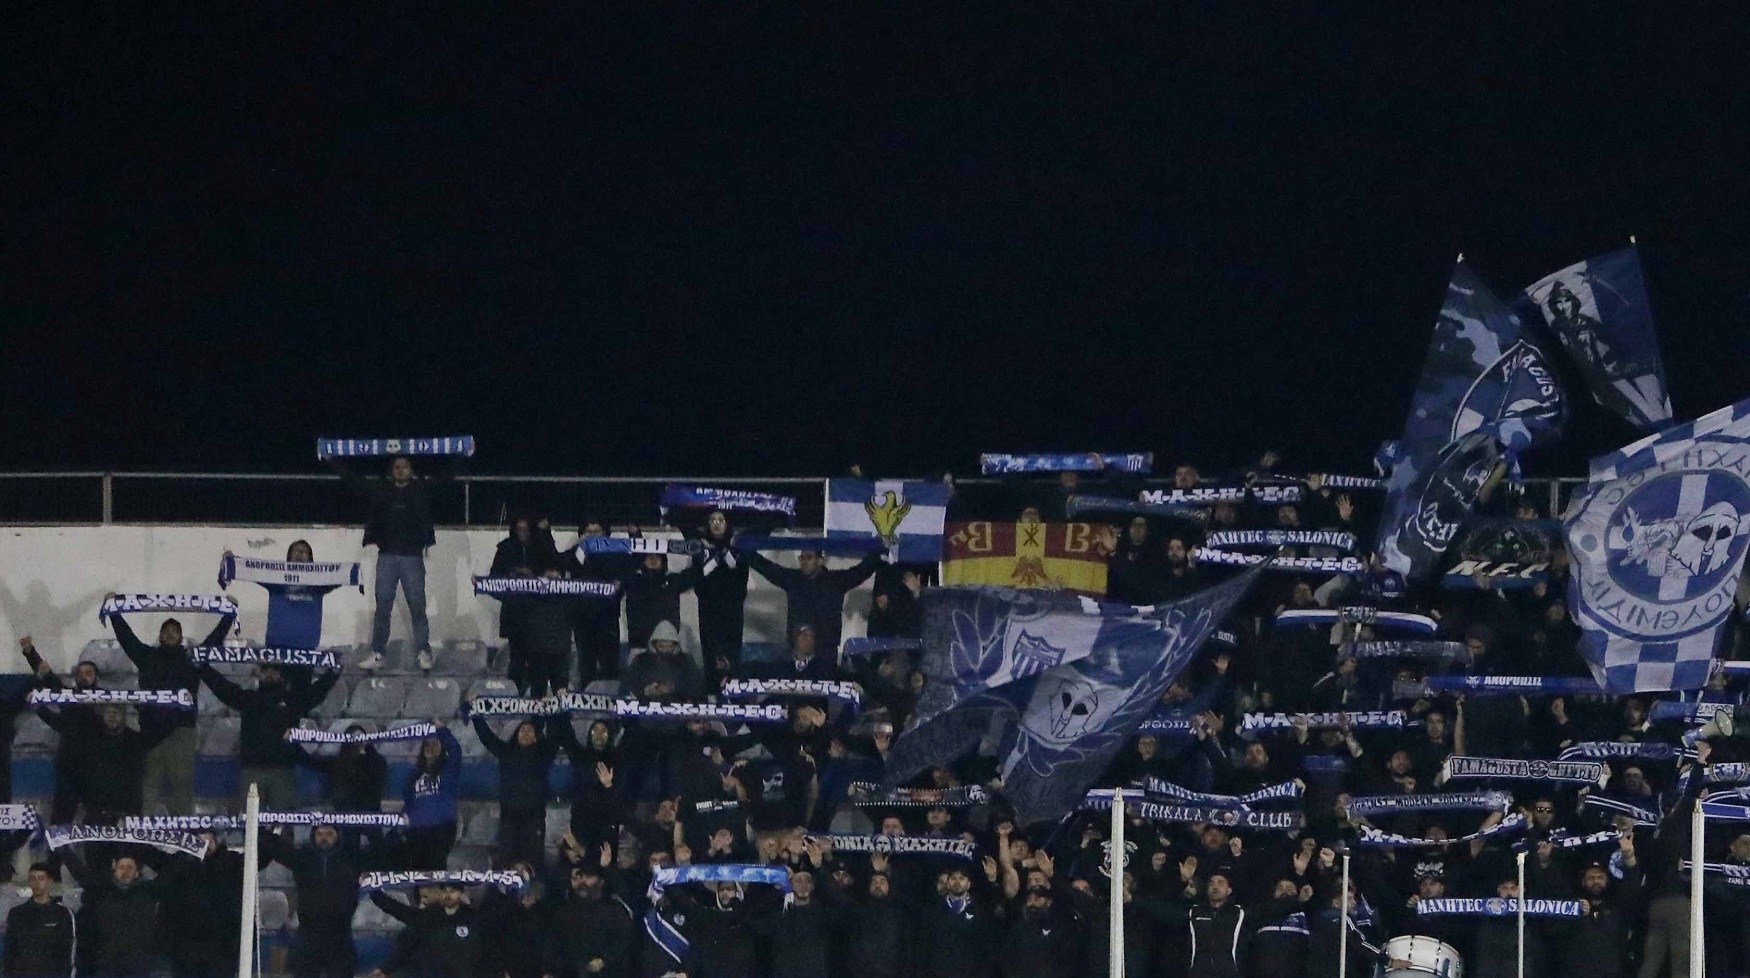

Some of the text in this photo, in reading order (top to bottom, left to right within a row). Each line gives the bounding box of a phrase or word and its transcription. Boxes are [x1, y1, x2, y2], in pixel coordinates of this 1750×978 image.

[1247, 812, 1292, 828] CLUB
[1418, 896, 1581, 916] ΜΑΧΗΤΕC SALONICA
